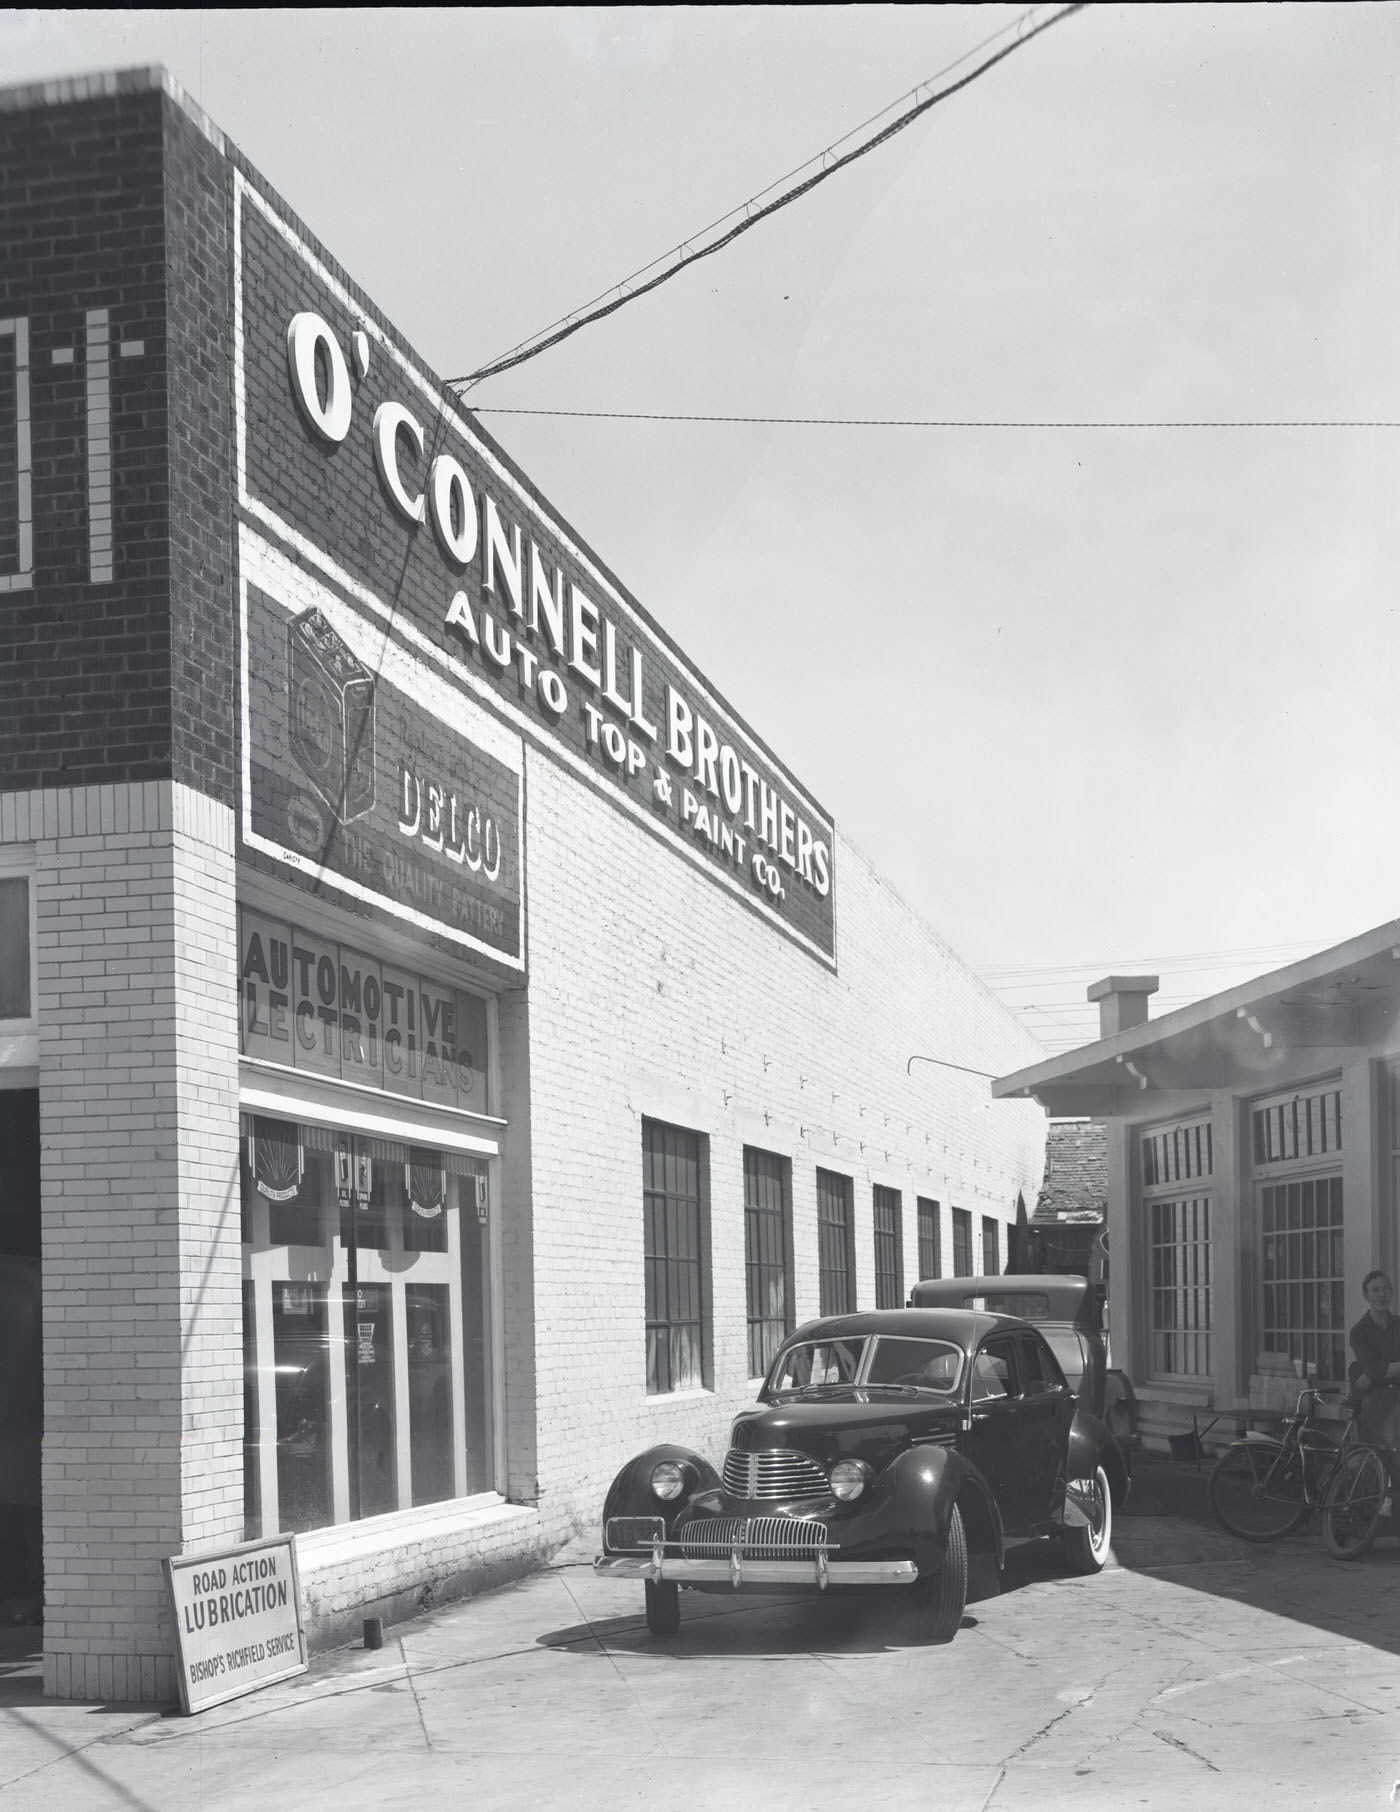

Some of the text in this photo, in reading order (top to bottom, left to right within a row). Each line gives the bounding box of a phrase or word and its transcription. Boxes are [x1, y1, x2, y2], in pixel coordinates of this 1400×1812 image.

[287, 311, 829, 896] O'CONNELL BROTHERS
[444, 590, 568, 713] AUTO
[584, 702, 646, 775] TOP
[653, 765, 672, 807] &
[684, 788, 746, 864] PAINT
[399, 768, 501, 882] DELCO
[237, 979, 474, 1095] LECTRICIANS
[244, 931, 457, 1045] AUTOMOTIVE
[184, 1580, 288, 1634] LUBRICATION
[193, 1556, 276, 1595] ROAD ACTION
[189, 1632, 295, 1684] BISHOP'S RICHFIELD SERVICE
